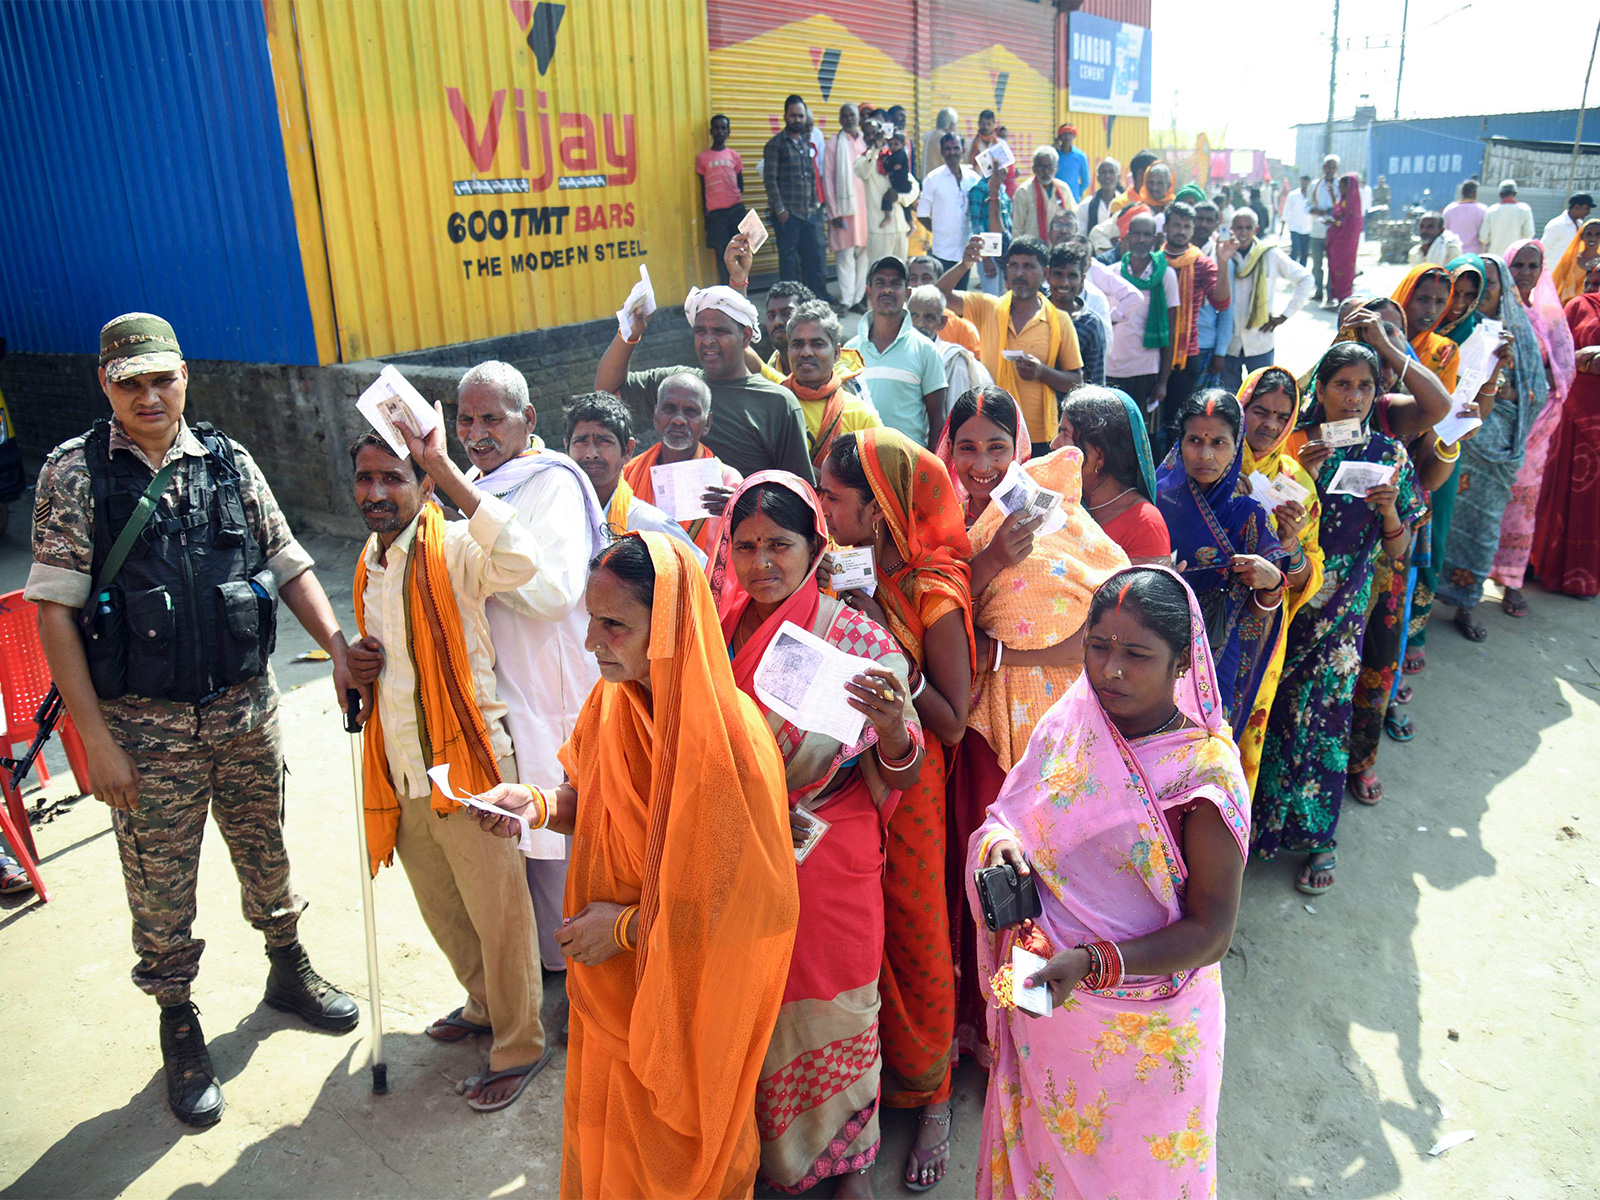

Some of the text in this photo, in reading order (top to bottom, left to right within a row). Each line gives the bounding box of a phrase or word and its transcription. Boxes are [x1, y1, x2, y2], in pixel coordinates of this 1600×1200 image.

[444, 86, 637, 193] Vijay
[1388, 154, 1463, 175] BANGUR
[574, 201, 635, 233] BARS
[463, 256, 502, 280] THE
[594, 239, 648, 262] STEEL
